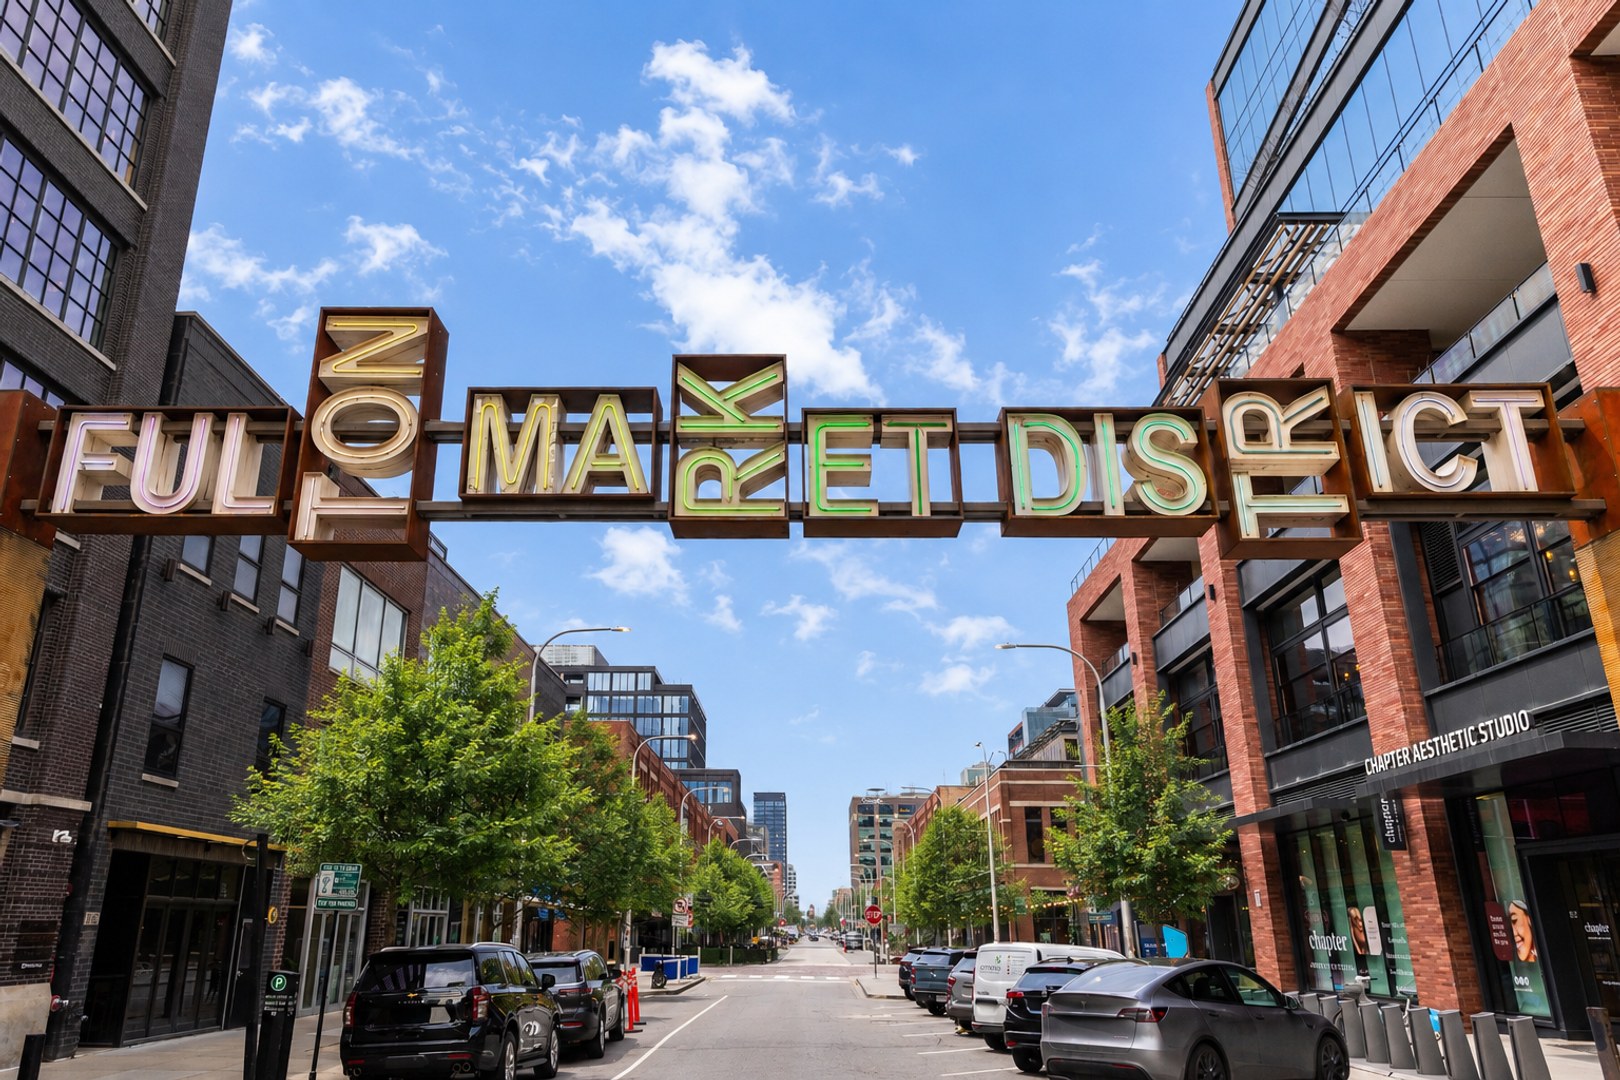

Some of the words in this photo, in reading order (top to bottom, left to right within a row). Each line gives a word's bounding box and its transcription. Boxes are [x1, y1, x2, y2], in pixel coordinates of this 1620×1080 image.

[50, 314, 429, 543] FULTON
[466, 359, 954, 518] MARKET
[1006, 383, 1545, 540] DISTRICT
[1365, 747, 1412, 776] CHAPTER
[1412, 725, 1477, 763] AESTHETIC
[1480, 709, 1530, 744] STUDIO
[1308, 930, 1348, 957] chapter
[1584, 921, 1610, 936] chapter
